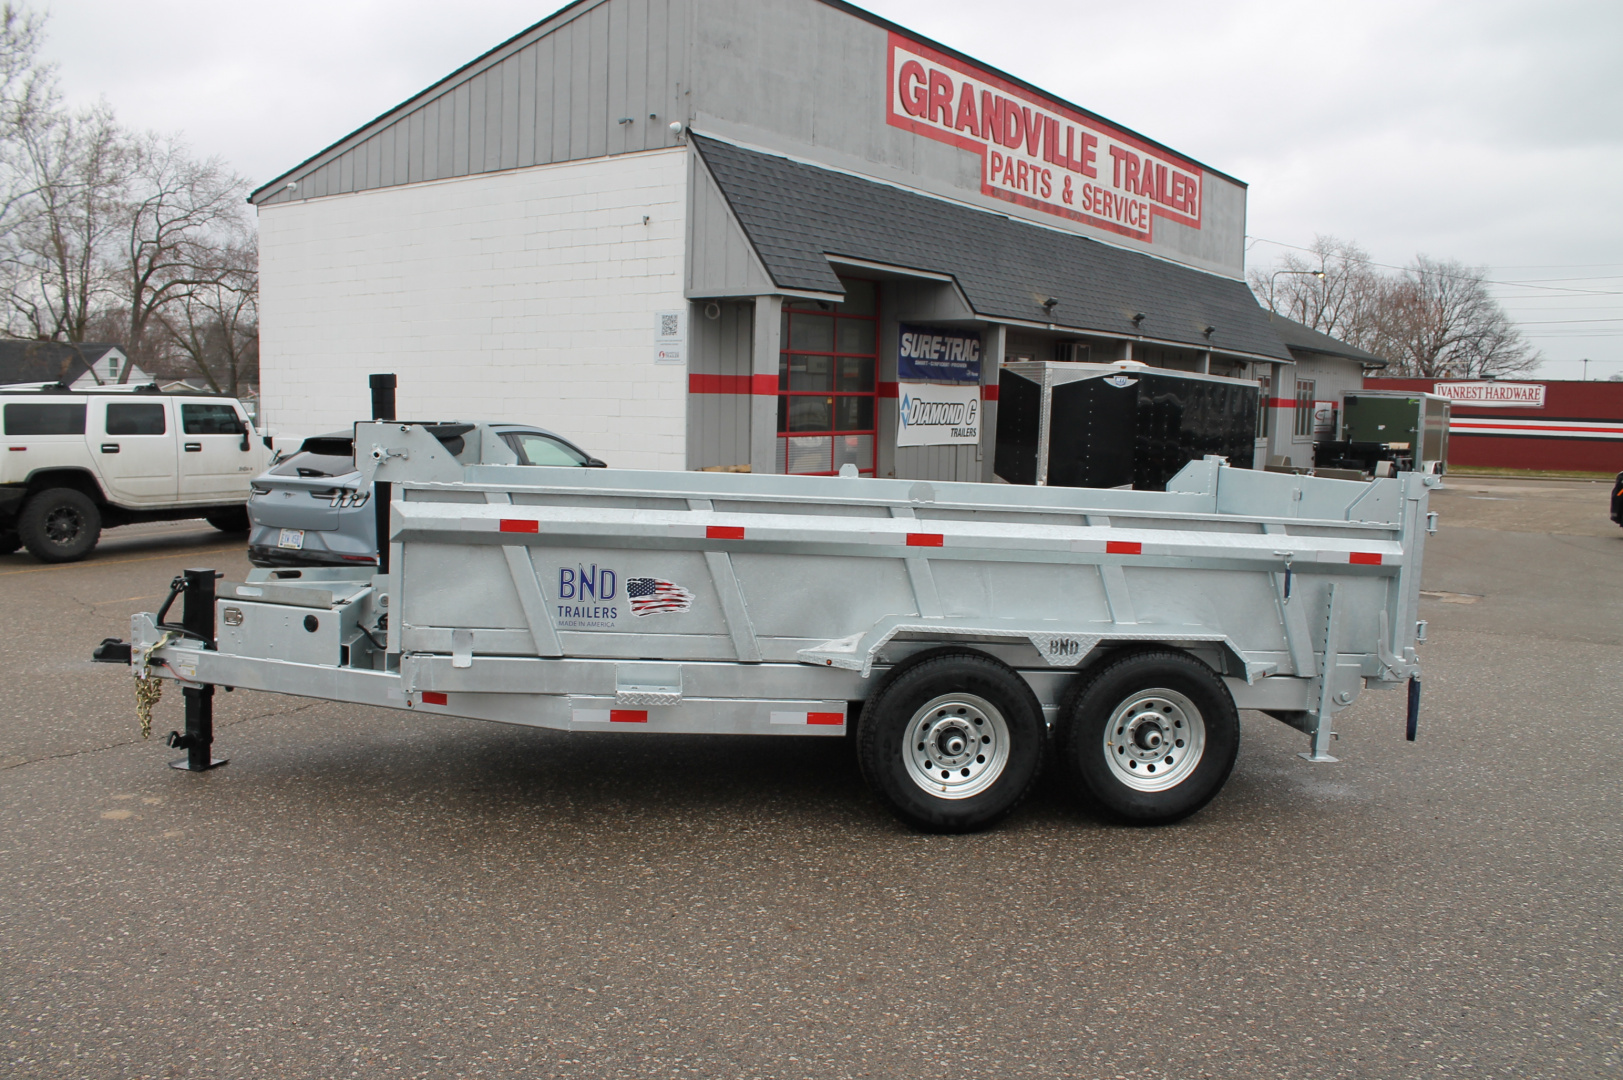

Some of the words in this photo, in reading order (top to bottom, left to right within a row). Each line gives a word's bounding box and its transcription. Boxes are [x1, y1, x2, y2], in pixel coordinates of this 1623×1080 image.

[900, 60, 1098, 178] GRANDVILLE
[1109, 144, 1197, 216] TRAILER
[991, 151, 1052, 199] PARTS
[1062, 175, 1073, 205] &
[1082, 182, 1148, 229] SERVICE
[900, 333, 980, 362] SURE-TRAC
[1437, 386, 1484, 399] IVANREST
[1485, 387, 1541, 400] HARDWARE
[907, 398, 965, 426] DIAMOND
[966, 399, 978, 426] C
[951, 428, 977, 437] TRAILERS
[558, 563, 618, 604] BND
[558, 605, 618, 619] TRAILERS
[1050, 638, 1079, 656] BND
